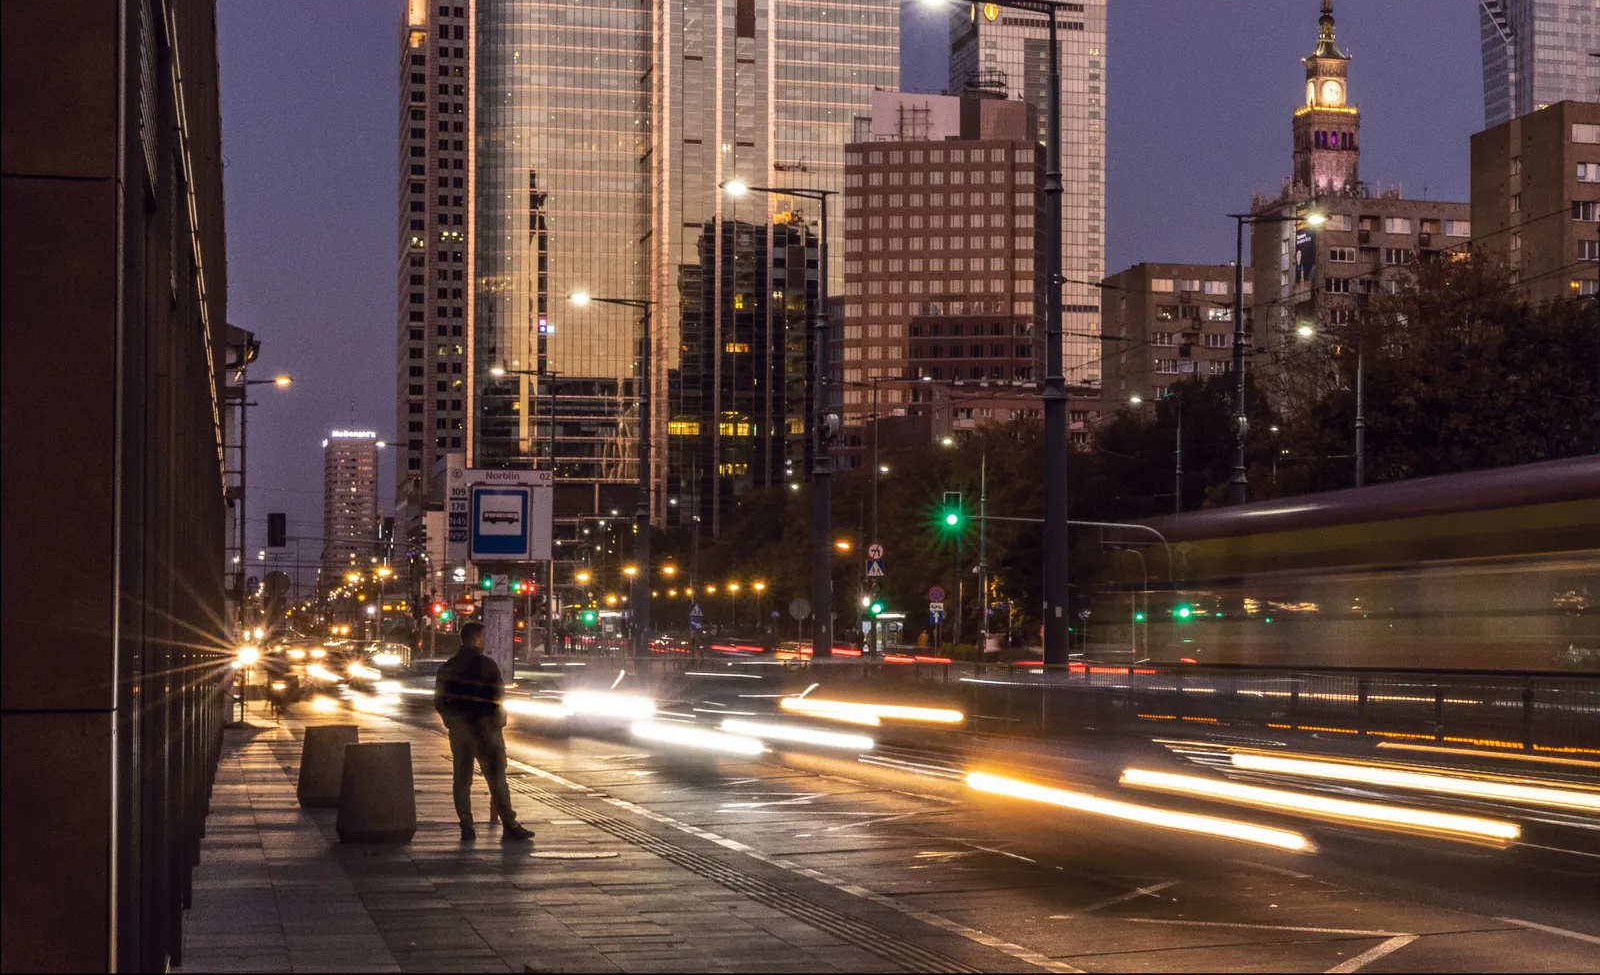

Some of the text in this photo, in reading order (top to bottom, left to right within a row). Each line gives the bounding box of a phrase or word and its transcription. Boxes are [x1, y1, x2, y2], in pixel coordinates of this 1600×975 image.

[485, 471, 550, 481] Norblin 02
[452, 502, 466, 510] 178
[450, 517, 467, 525] N45
[450, 532, 467, 540] N95
